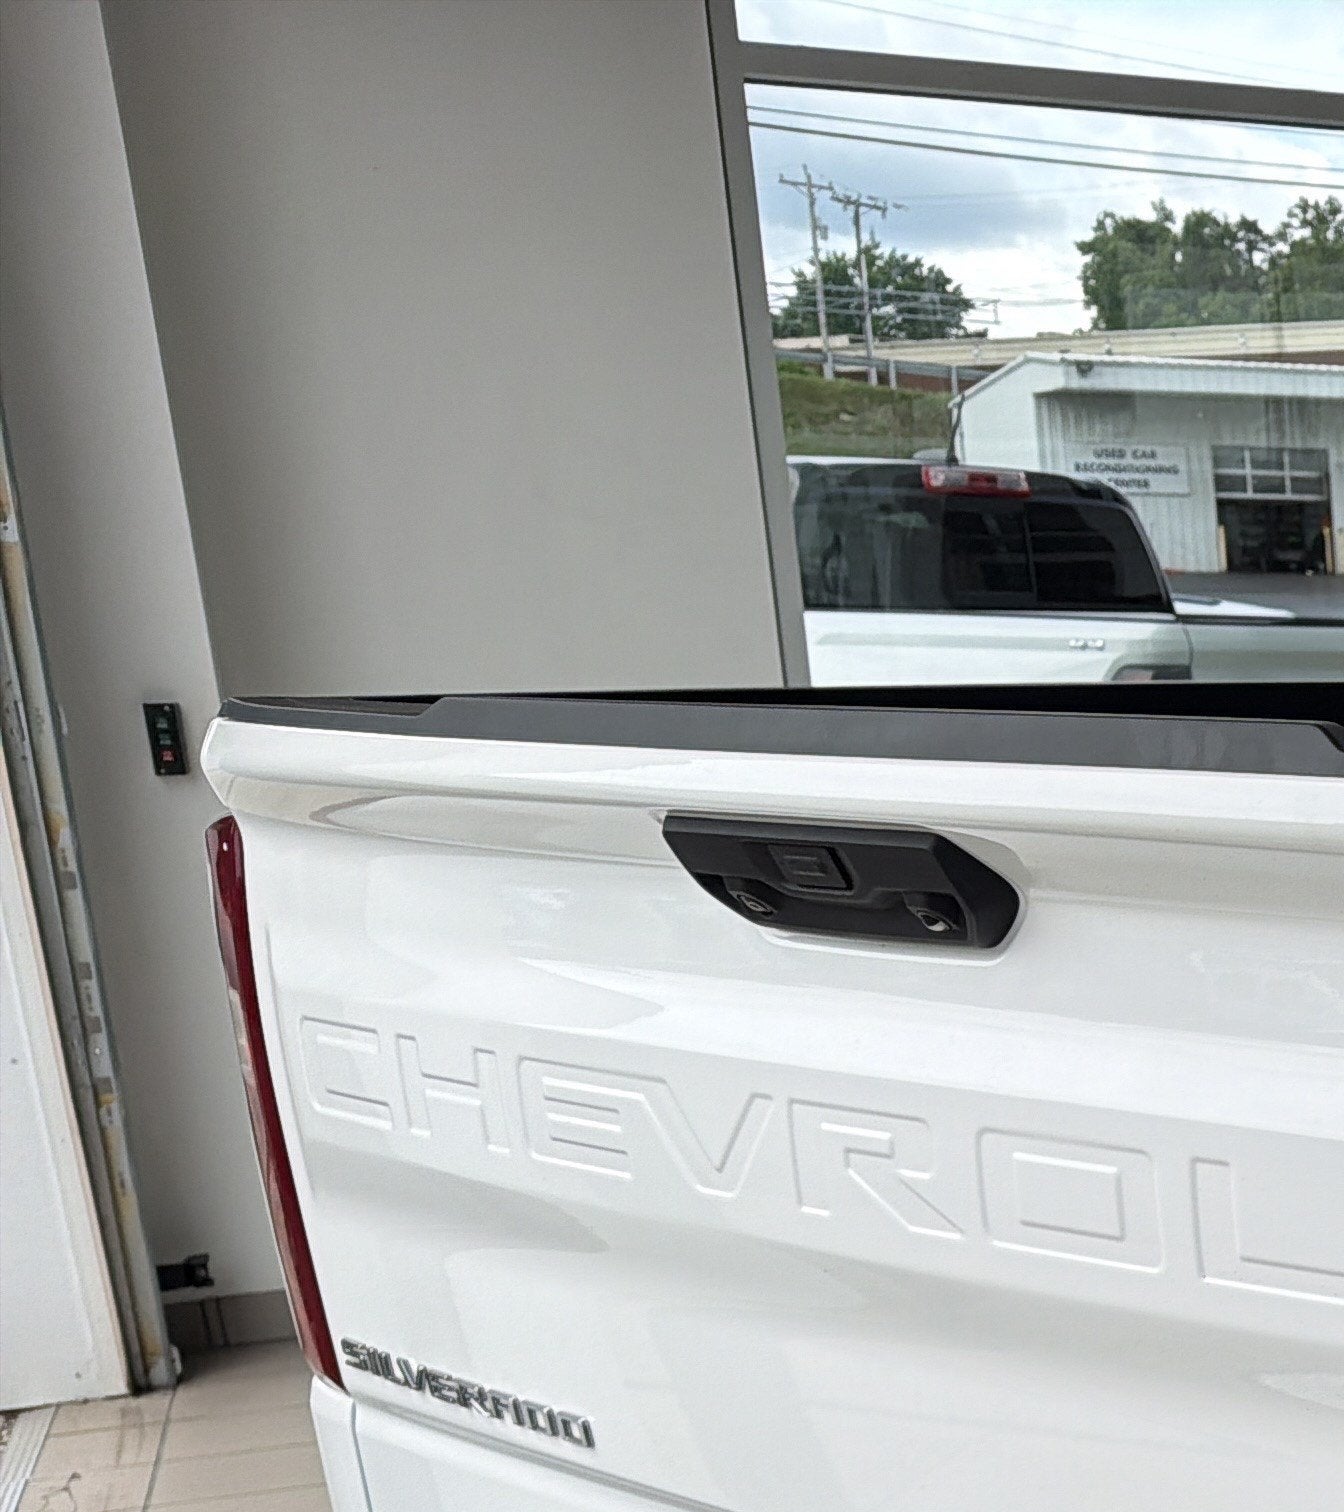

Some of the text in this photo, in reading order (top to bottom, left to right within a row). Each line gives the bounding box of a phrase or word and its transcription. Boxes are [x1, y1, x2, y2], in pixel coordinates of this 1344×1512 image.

[1092, 448, 1158, 460] USED CAR
[341, 1337, 596, 1449] SILVERADO
